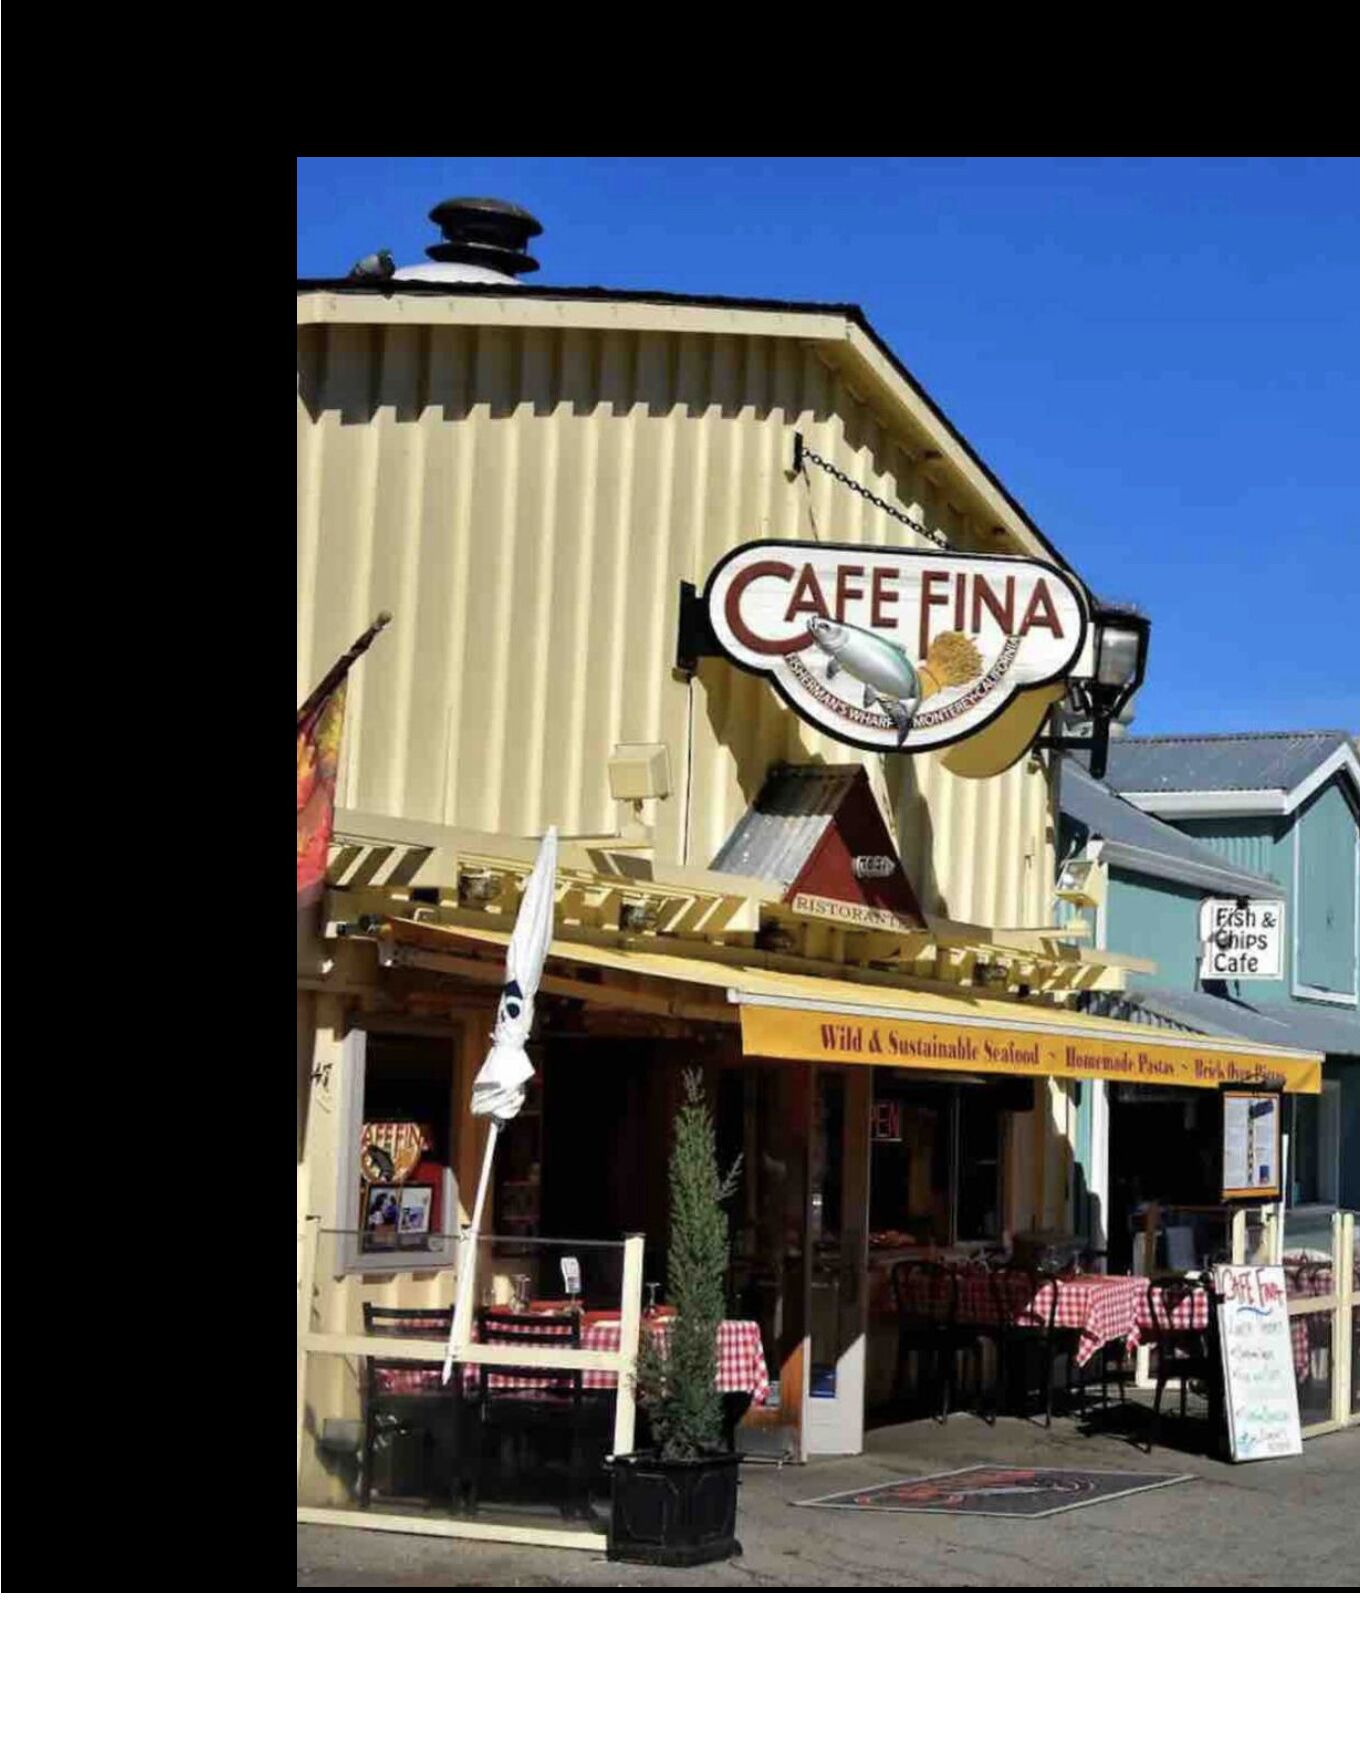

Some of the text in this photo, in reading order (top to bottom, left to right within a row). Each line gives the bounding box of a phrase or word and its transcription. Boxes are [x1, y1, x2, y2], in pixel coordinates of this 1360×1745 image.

[724, 560, 1064, 660] CAFE FINA
[796, 895, 911, 933] RISTORANT
[1216, 907, 1277, 929] Fish &
[1215, 928, 1269, 951] Chips
[1214, 953, 1259, 973] Cafe
[820, 1023, 863, 1052] Wild
[868, 1029, 883, 1054] &
[888, 1029, 978, 1061] Sustainable
[983, 1039, 1040, 1065] Seafood
[1066, 1045, 1134, 1073] Homemade
[1138, 1053, 1176, 1076] Pastas
[1194, 1058, 1227, 1081] Brick
